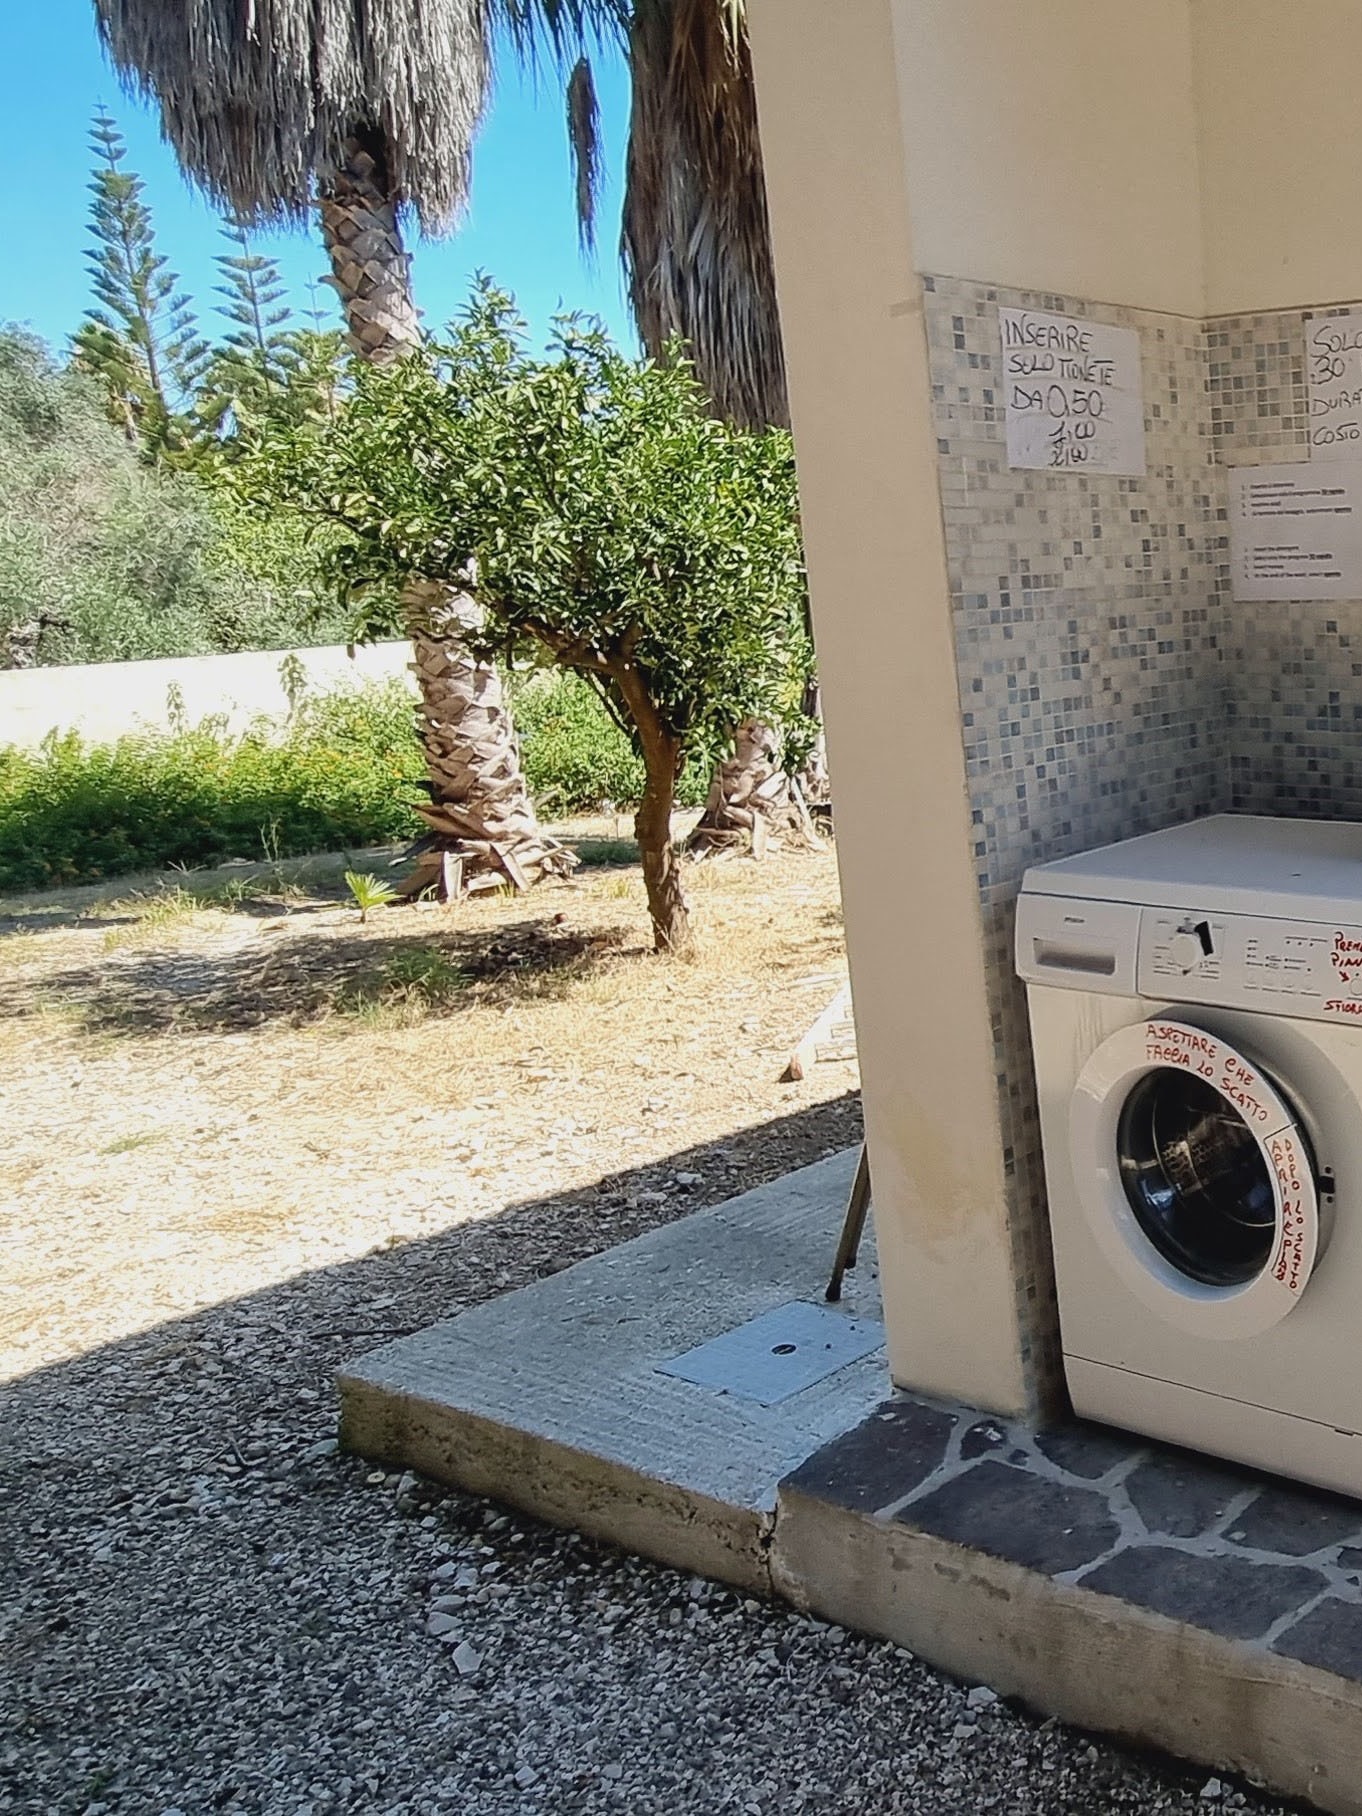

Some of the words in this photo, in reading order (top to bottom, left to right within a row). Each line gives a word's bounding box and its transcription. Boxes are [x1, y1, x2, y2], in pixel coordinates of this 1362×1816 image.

[1005, 313, 1094, 352] INSERIRE
[1008, 353, 1055, 375] SOLO
[1312, 422, 1360, 445] COSTO
[1145, 1023, 1218, 1059] ASPETTARE
[1224, 1058, 1255, 1086] CHE
[1196, 1060, 1214, 1077] LO
[1220, 1077, 1268, 1121] SCATTO
